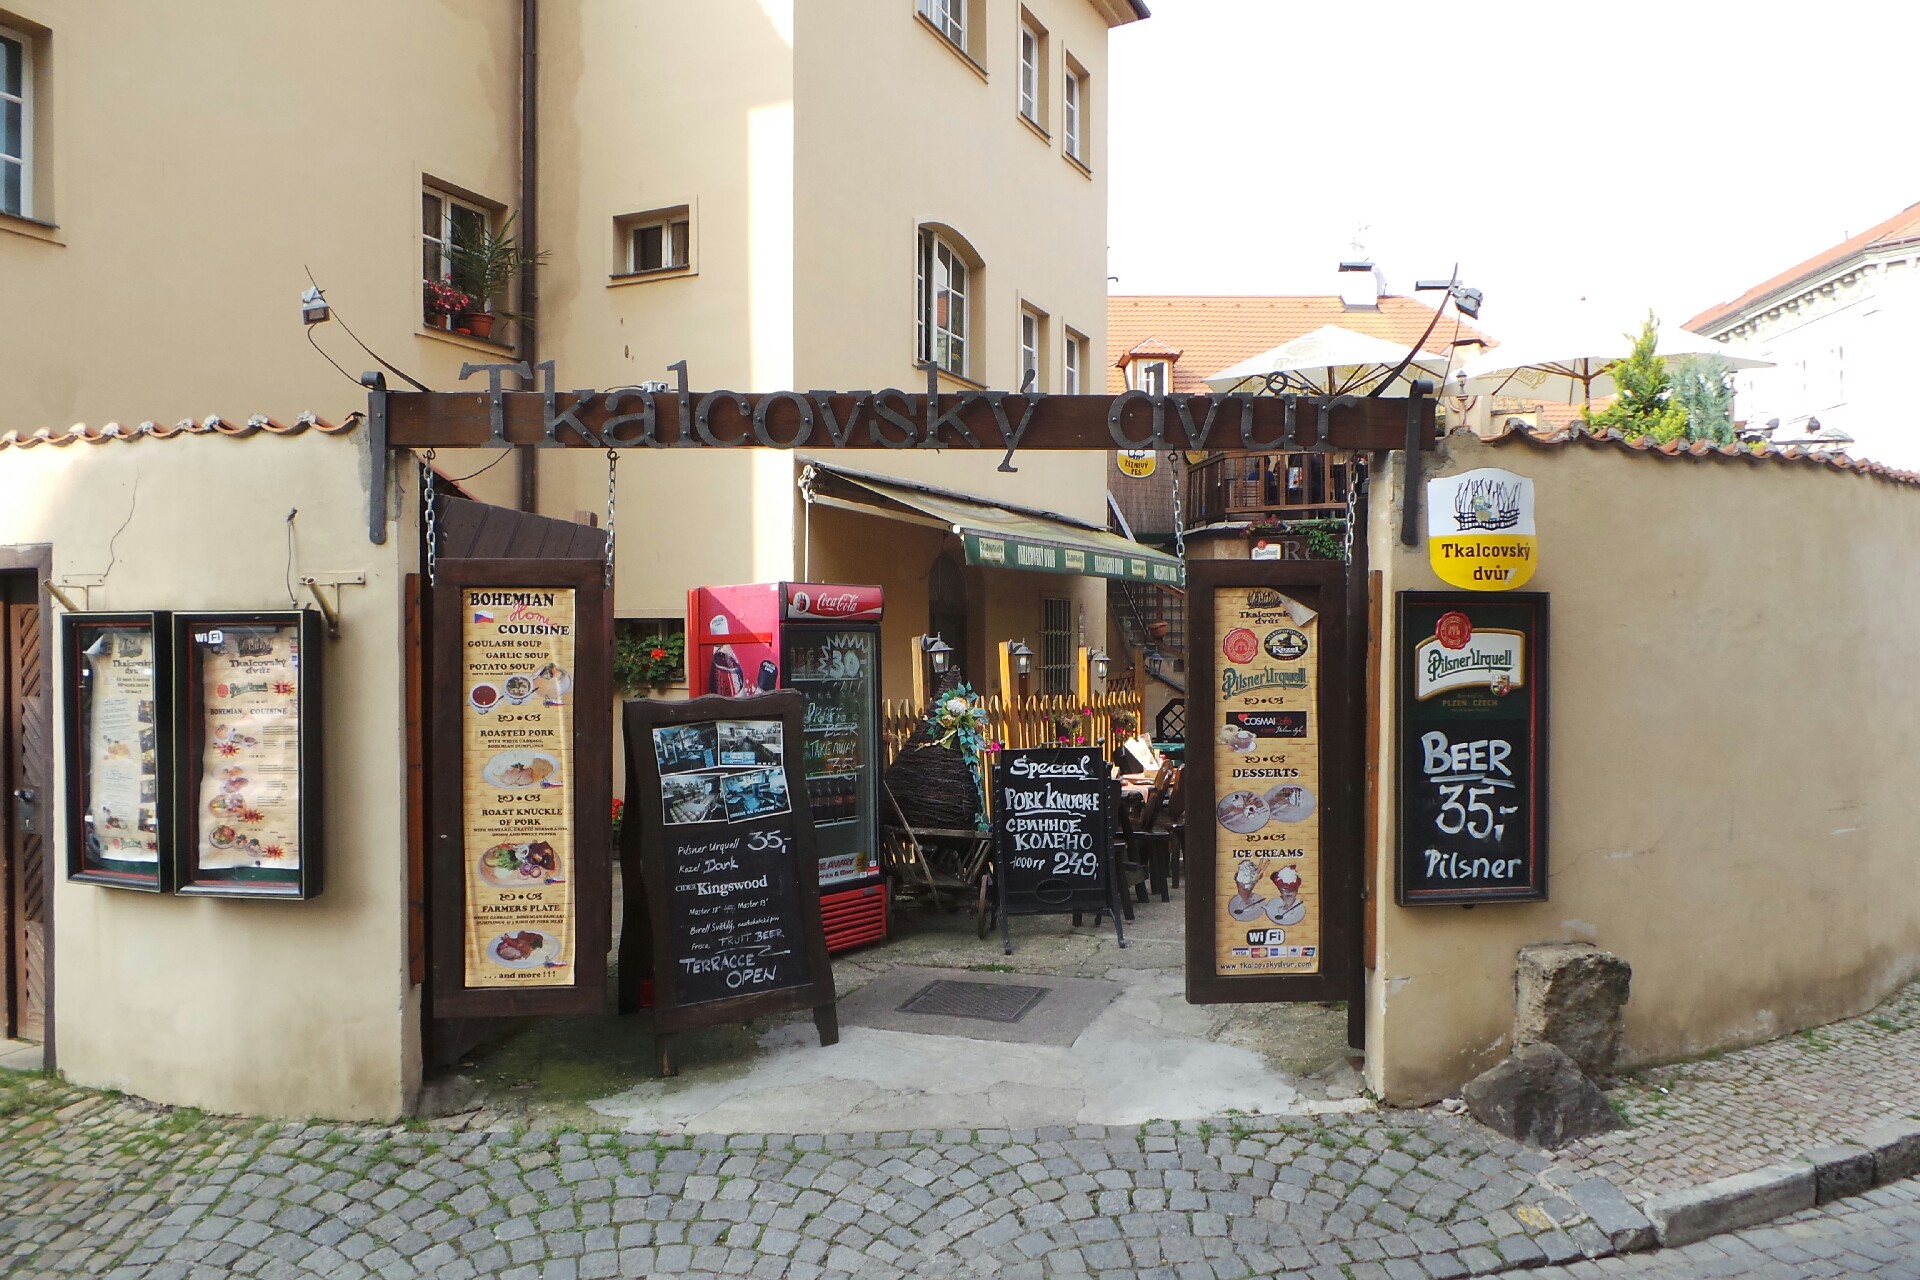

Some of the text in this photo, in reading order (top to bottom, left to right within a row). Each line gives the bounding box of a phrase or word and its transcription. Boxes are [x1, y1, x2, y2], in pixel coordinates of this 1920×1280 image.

[458, 359, 1357, 473] Tkalcovský dvůr
[1131, 468, 1142, 476] PES
[1441, 541, 1531, 561] Tkalcovský
[469, 592, 555, 606] BOHEMIAN
[509, 602, 558, 626] Home
[1239, 610, 1292, 619] Tkalcovsk
[497, 624, 570, 635] COUISINE
[1272, 645, 1301, 654] Kozel
[228, 658, 287, 668] Tkalcovský
[1427, 647, 1513, 683] Pilsner Urquell
[1221, 665, 1308, 700] Pilsner Urquell
[209, 707, 243, 716] BOHEMIAN
[1243, 717, 1276, 726] COSMAI
[480, 729, 555, 737] ROASTED PORK
[809, 740, 857, 758] TAKE AWAY
[1420, 730, 1513, 777] BEER
[1009, 754, 1091, 780] Special
[1231, 768, 1299, 778] DESSERTS
[1004, 782, 1100, 811] PORK KNUCKLE
[481, 808, 563, 816] ROAST KNUCKLE
[1005, 818, 1082, 833] СВИННОЕ
[677, 844, 708, 856] Pilsner
[708, 837, 741, 855] Urquell
[1013, 832, 1093, 851] КОЛЕНО
[1232, 848, 1305, 859] ICE CREAMS
[703, 855, 740, 875] Dark
[1424, 849, 1523, 880] Pilsner
[675, 874, 769, 897] CIDER Kingswood
[482, 904, 560, 913] FARMERS PLATE
[688, 907, 711, 916] Master
[737, 901, 759, 910] Master
[718, 931, 752, 947] FRUIT
[754, 928, 785, 943] BEER
[679, 953, 756, 974] TERRACCE
[726, 964, 777, 989] OPEN
